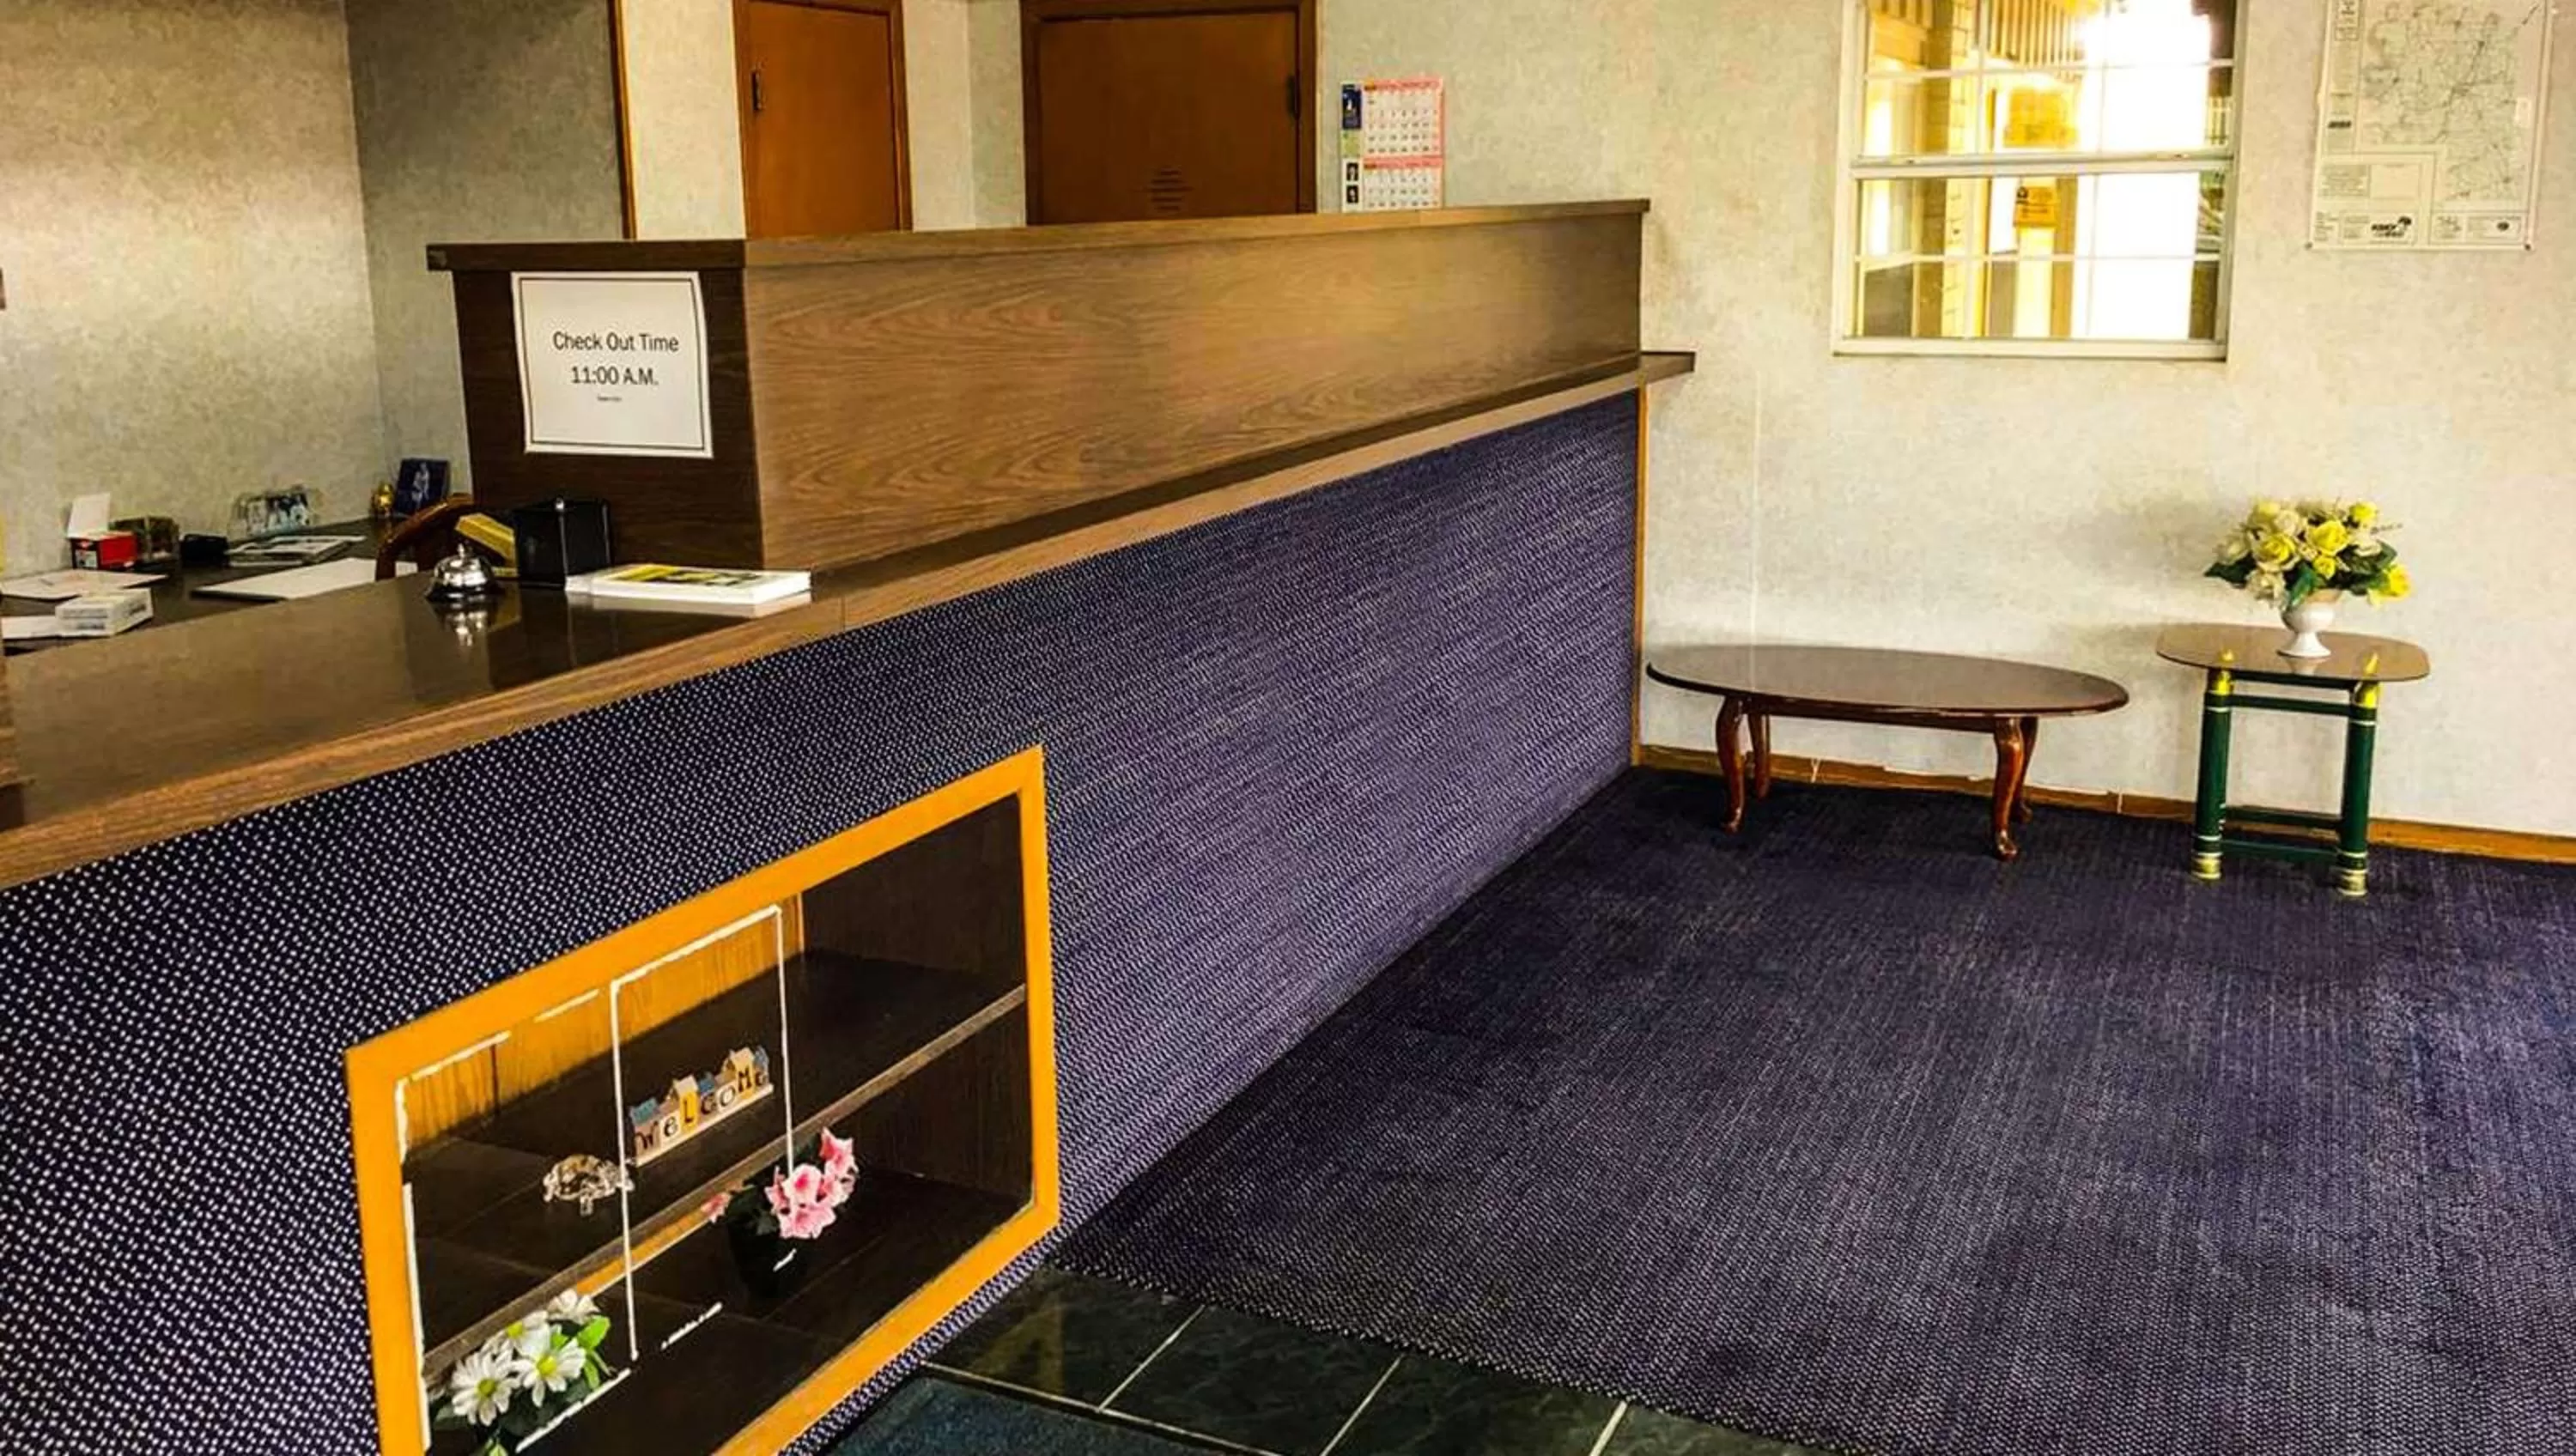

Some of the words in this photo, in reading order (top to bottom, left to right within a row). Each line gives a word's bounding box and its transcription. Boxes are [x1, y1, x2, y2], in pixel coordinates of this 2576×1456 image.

[552, 331, 604, 351] Check
[606, 332, 635, 352] Out
[639, 333, 679, 352] Time
[571, 366, 619, 385] 11:00
[623, 367, 659, 385] A.M.
